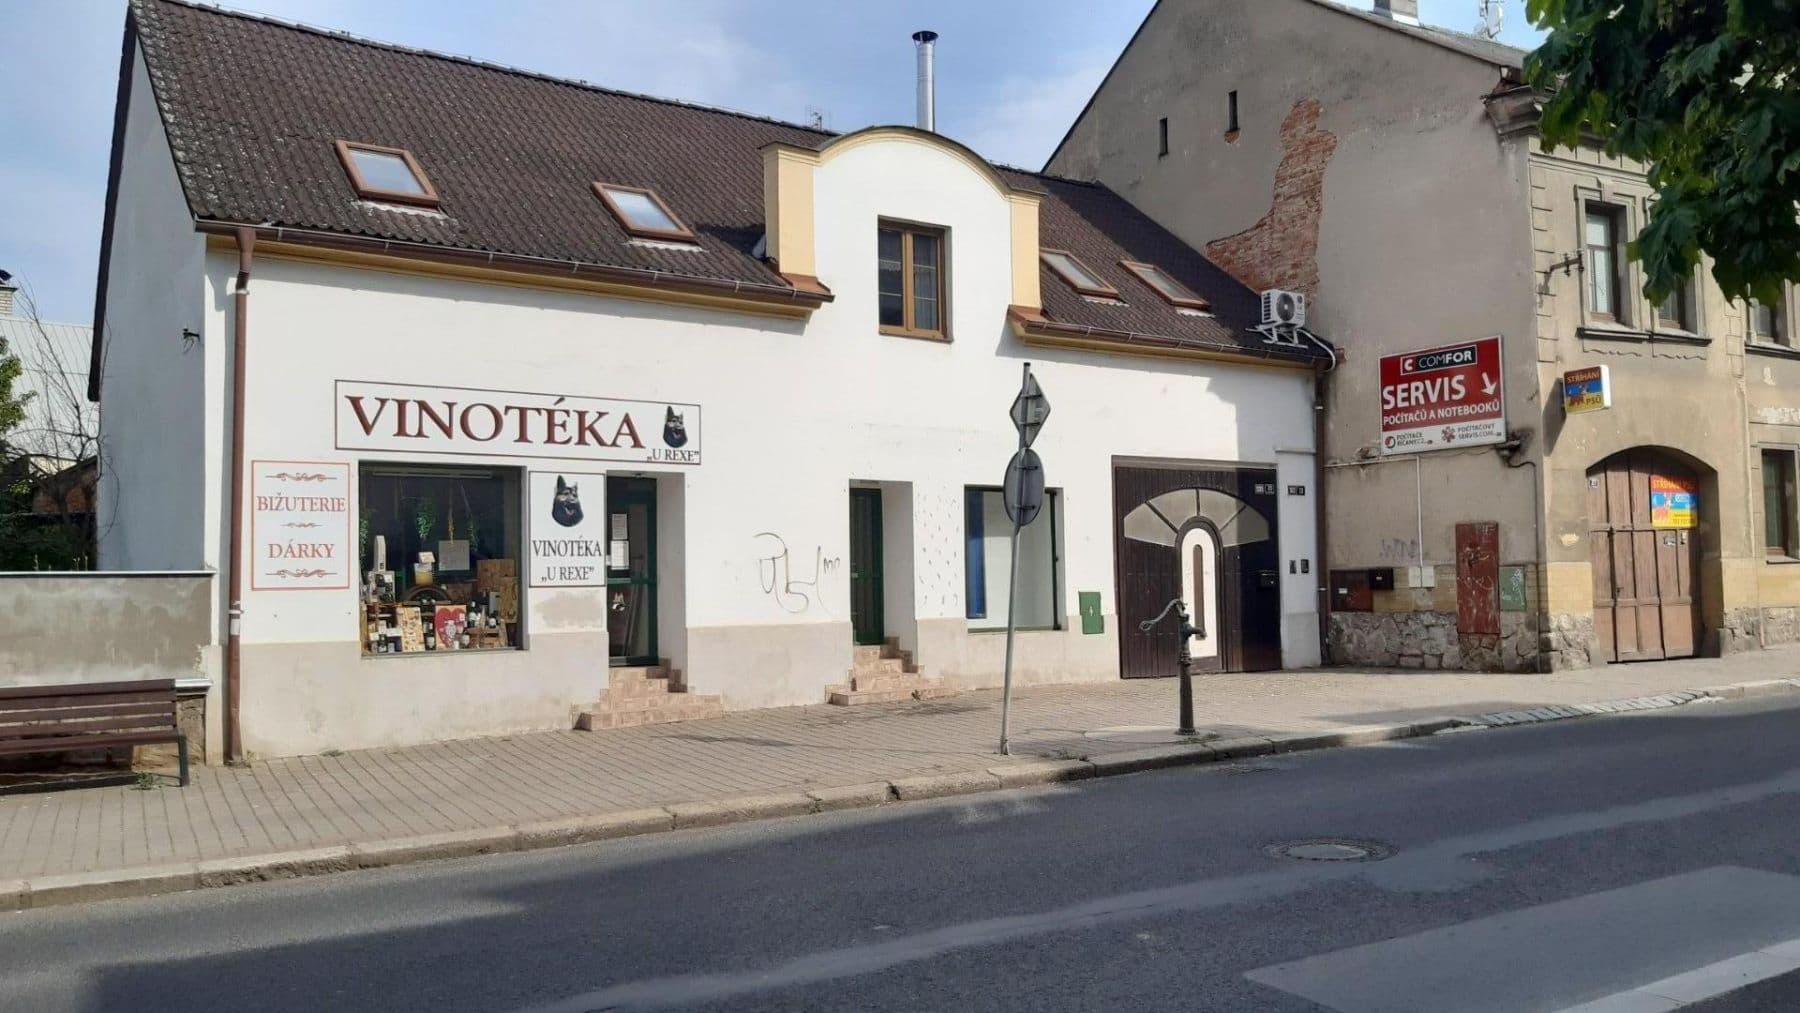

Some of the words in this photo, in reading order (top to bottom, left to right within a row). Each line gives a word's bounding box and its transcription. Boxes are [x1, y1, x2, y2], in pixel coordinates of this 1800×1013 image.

[1419, 350, 1473, 369] COMFOR
[1382, 374, 1466, 410] SERVIS
[345, 395, 647, 449] VINOTÉKA
[1383, 409, 1427, 426] POČÍTAČŮ
[1429, 409, 1437, 420] A
[1438, 399, 1500, 418] NOTEBOOKŮ
[256, 491, 346, 512] BIŽUTERIE
[268, 538, 334, 559] DÁRKY
[532, 534, 602, 557] VINOTÉKA
